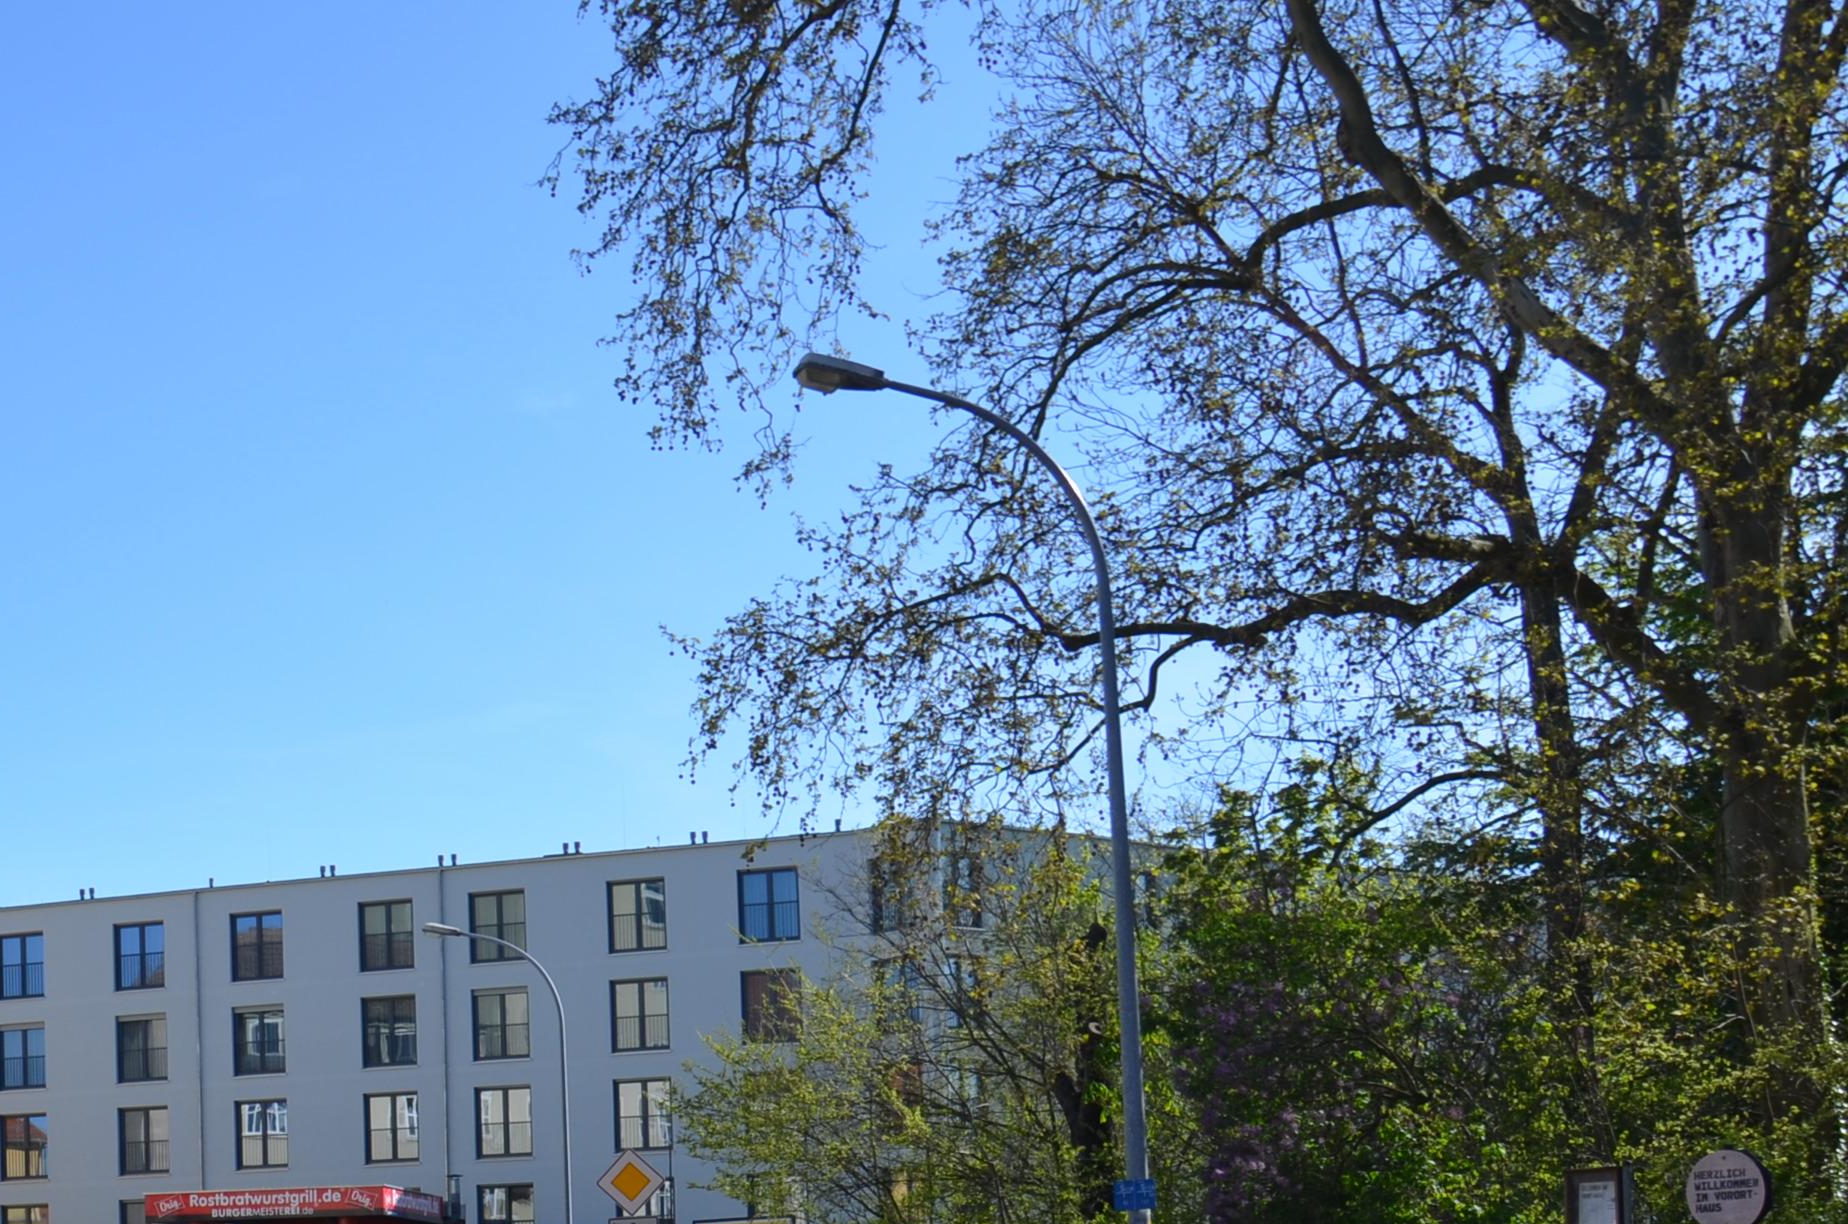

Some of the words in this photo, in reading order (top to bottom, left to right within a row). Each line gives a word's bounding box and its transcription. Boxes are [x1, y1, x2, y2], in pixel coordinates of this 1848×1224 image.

[1693, 1168, 1746, 1180] HERZLICH
[1694, 1178, 1759, 1191] WILLKOMMEN
[189, 1189, 341, 1208] Rostbratwurstgrill.de
[1695, 1193, 1708, 1203] IM
[1714, 1190, 1758, 1201] VORORT-
[1695, 1203, 1722, 1213] HAUS
